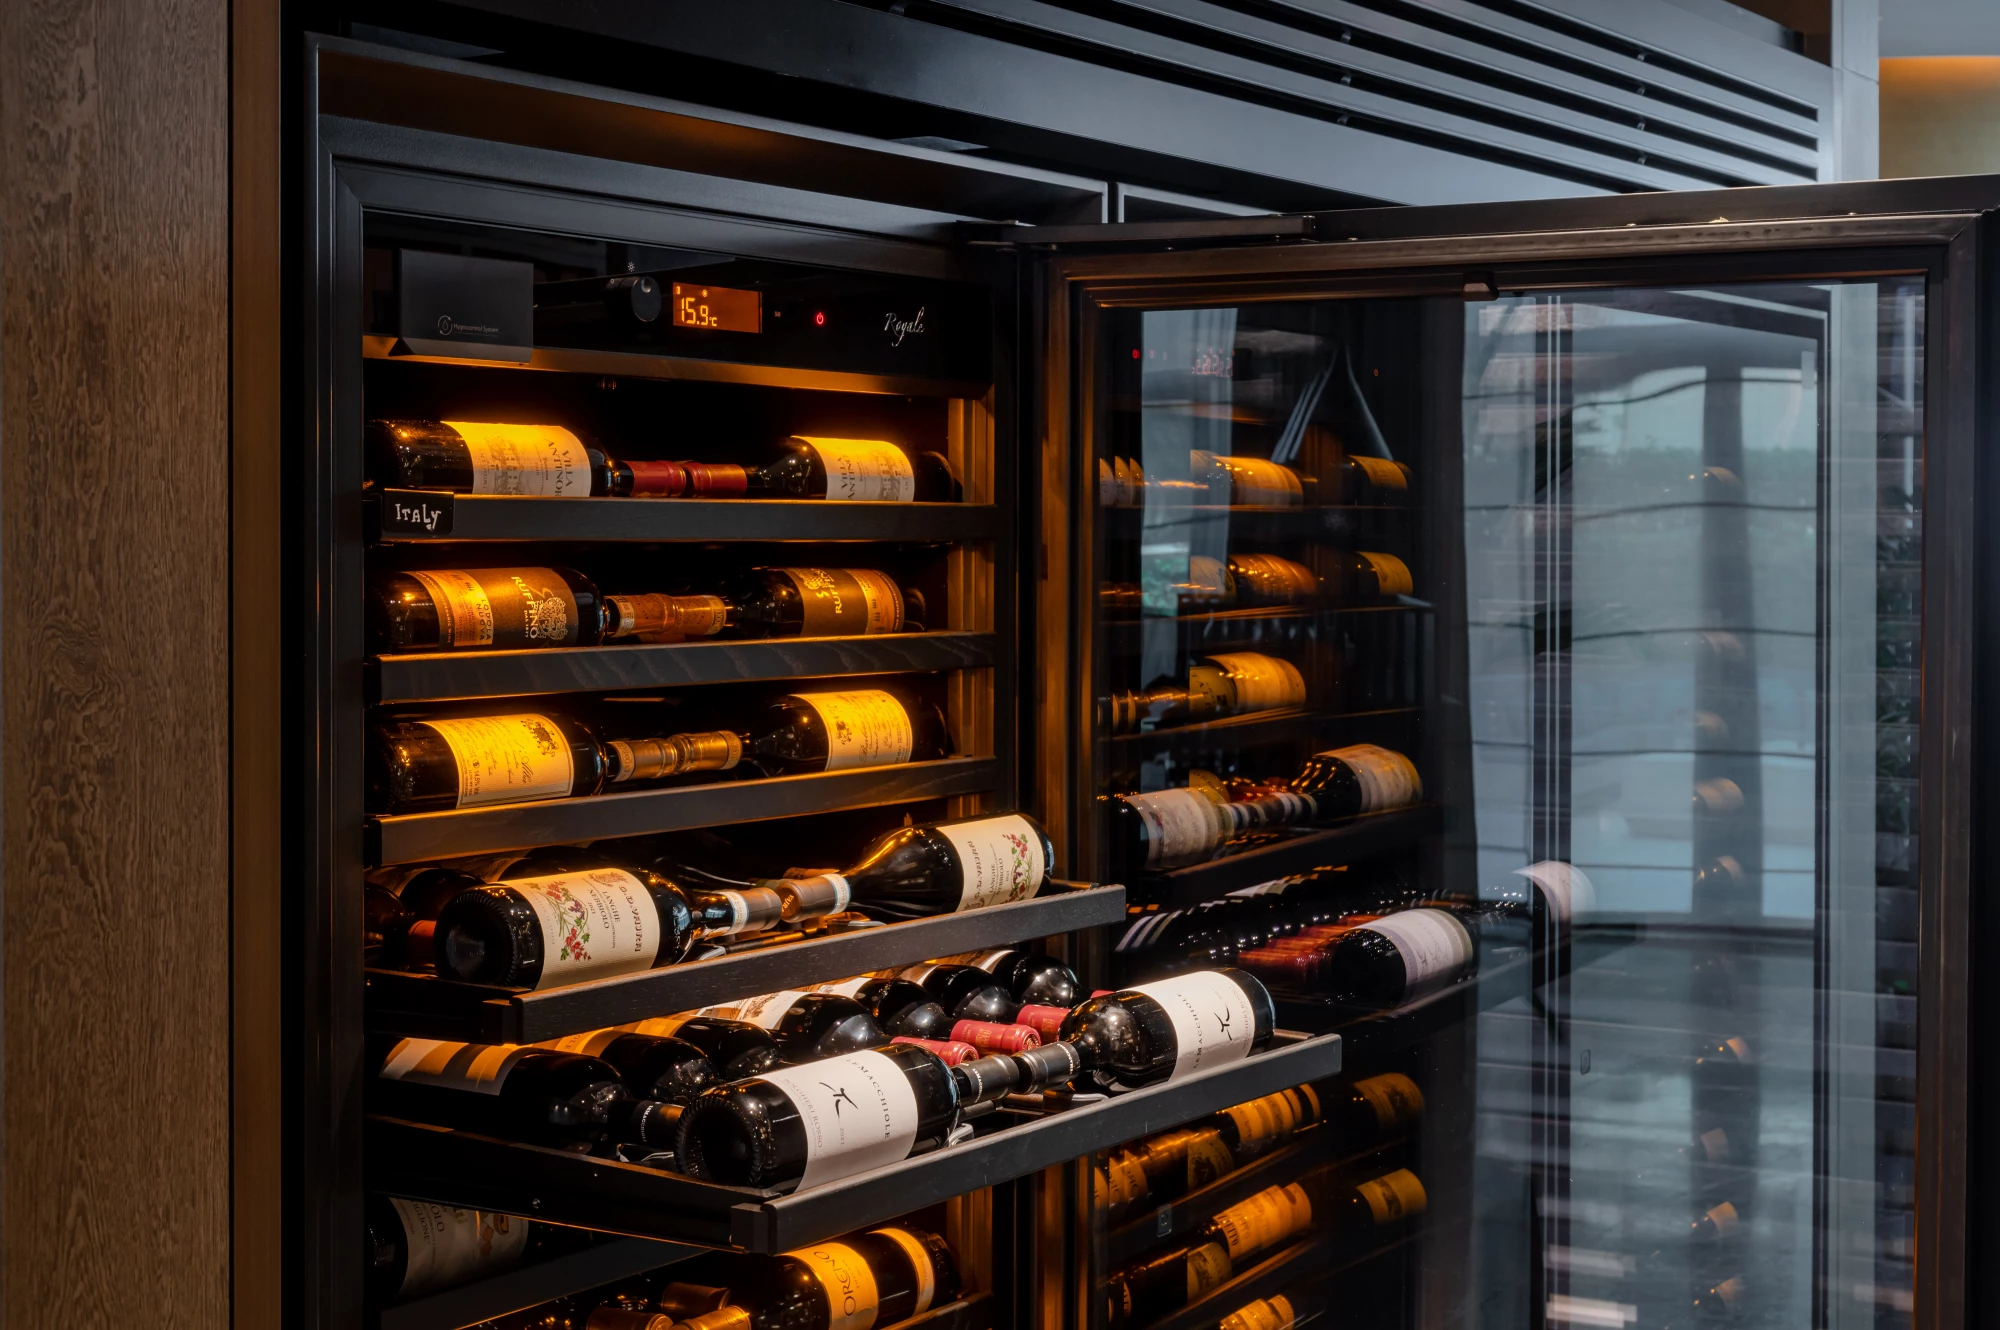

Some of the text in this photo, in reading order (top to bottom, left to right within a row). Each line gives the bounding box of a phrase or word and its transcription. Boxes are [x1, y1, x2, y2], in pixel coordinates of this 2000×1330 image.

[453, 322, 499, 334] Hygrocontrol System
[884, 306, 925, 347] Royale
[547, 440, 564, 497] ANTINOR
[562, 450, 573, 487] VILLA
[838, 457, 848, 489] VILLA
[476, 603, 485, 640] NUOVA
[481, 599, 492, 640] LODOLA
[511, 576, 538, 638] RUFFINO
[587, 889, 610, 929] NEBBIOLO
[602, 891, 620, 922] LANGHE
[784, 1078, 815, 1113] BOLGHERI
[812, 1115, 823, 1148] ROSSO
[429, 1204, 444, 1232] OLO
[814, 1251, 856, 1316] ORENO
